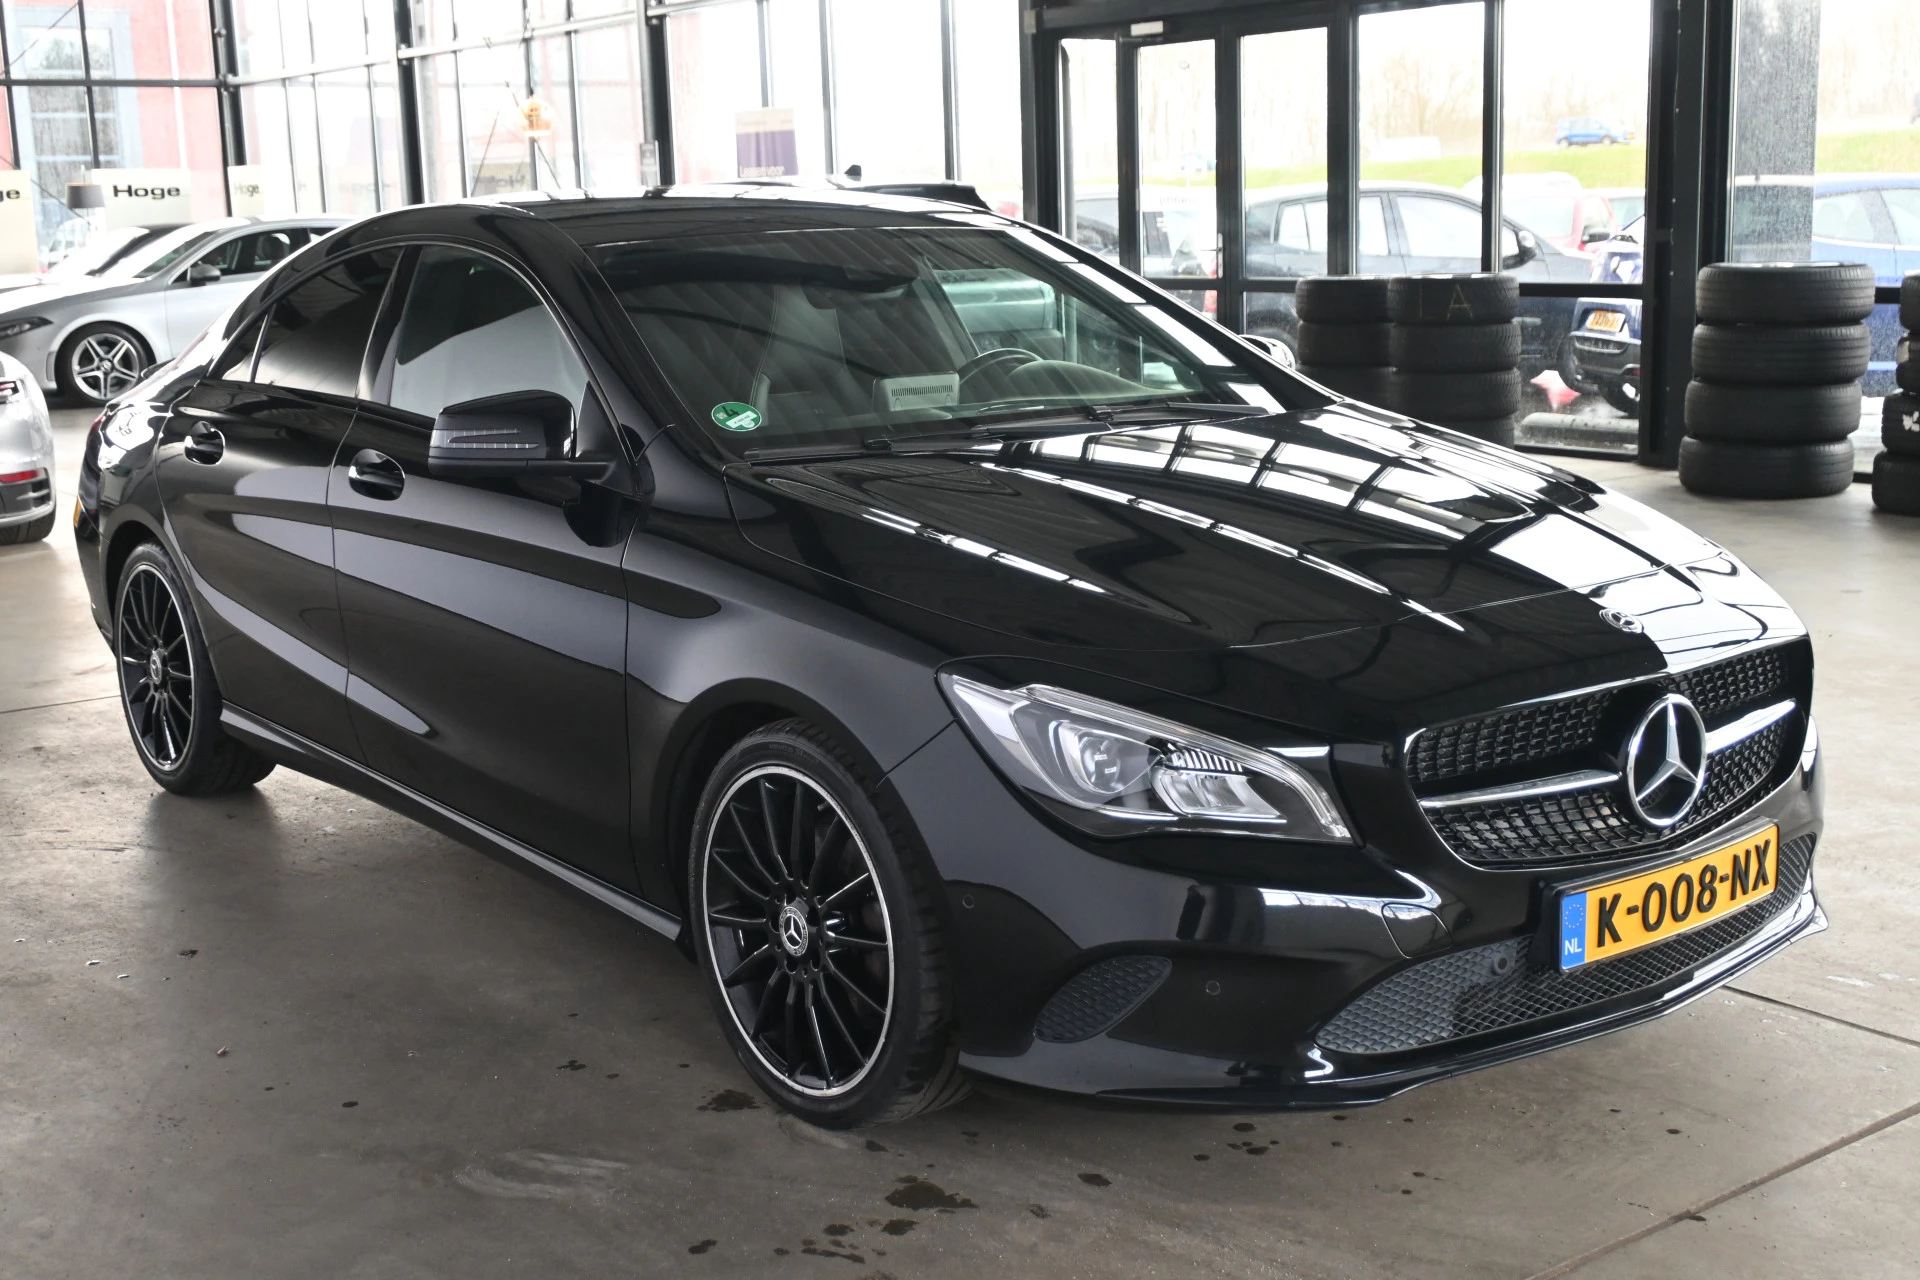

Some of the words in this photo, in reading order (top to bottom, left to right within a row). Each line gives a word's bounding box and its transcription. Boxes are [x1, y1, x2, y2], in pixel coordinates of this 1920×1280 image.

[112, 184, 181, 200] Hoge
[1597, 838, 1772, 948] K-008-NX
[1564, 936, 1583, 955] NL
